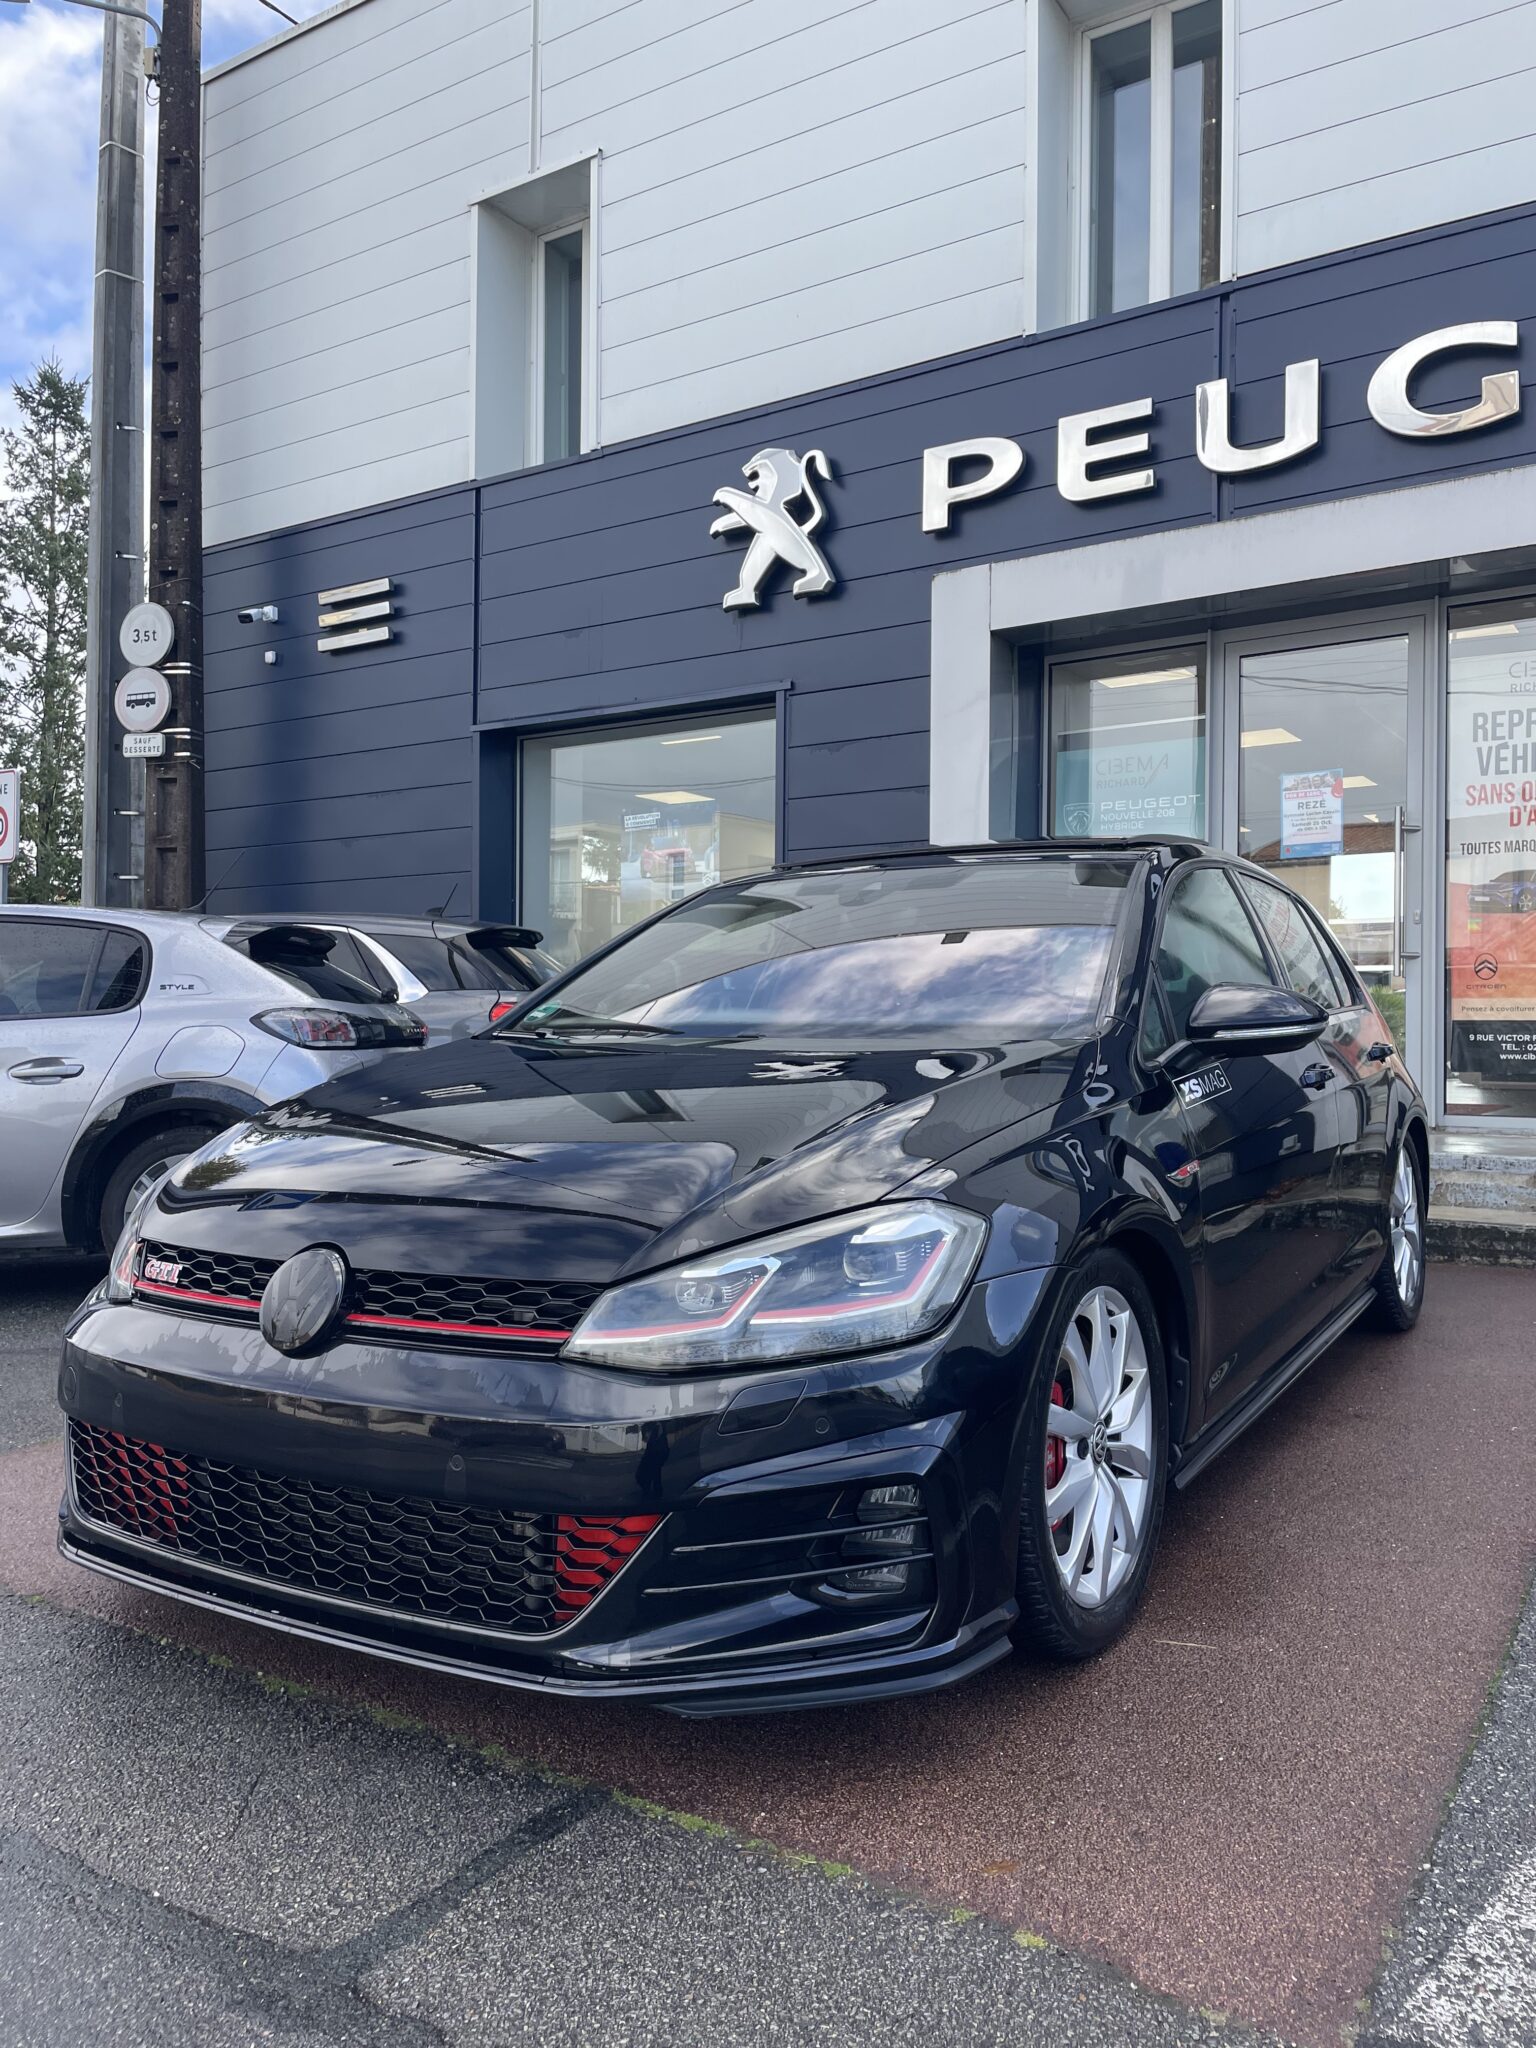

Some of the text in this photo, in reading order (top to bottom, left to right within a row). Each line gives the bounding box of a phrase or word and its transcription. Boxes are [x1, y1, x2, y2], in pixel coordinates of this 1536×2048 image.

[922, 320, 1521, 534] PEUG
[132, 628, 158, 644] 3,5 t
[133, 737, 152, 745] SAUF
[124, 746, 161, 754] DESSERTE
[1096, 776, 1145, 790] RICHARD
[1465, 781, 1536, 806] SANS O
[1101, 794, 1200, 811] PEUGEOT
[1297, 799, 1327, 810] REZÉ
[1101, 808, 1175, 822] NOUVELLE 208
[1101, 821, 1144, 831] HYBRIDE
[1460, 839, 1536, 855] TOUTES MARQ
[1501, 1043, 1520, 1051] TEL.
[1179, 1069, 1227, 1103] XSMAG
[144, 1259, 183, 1284] GTI
